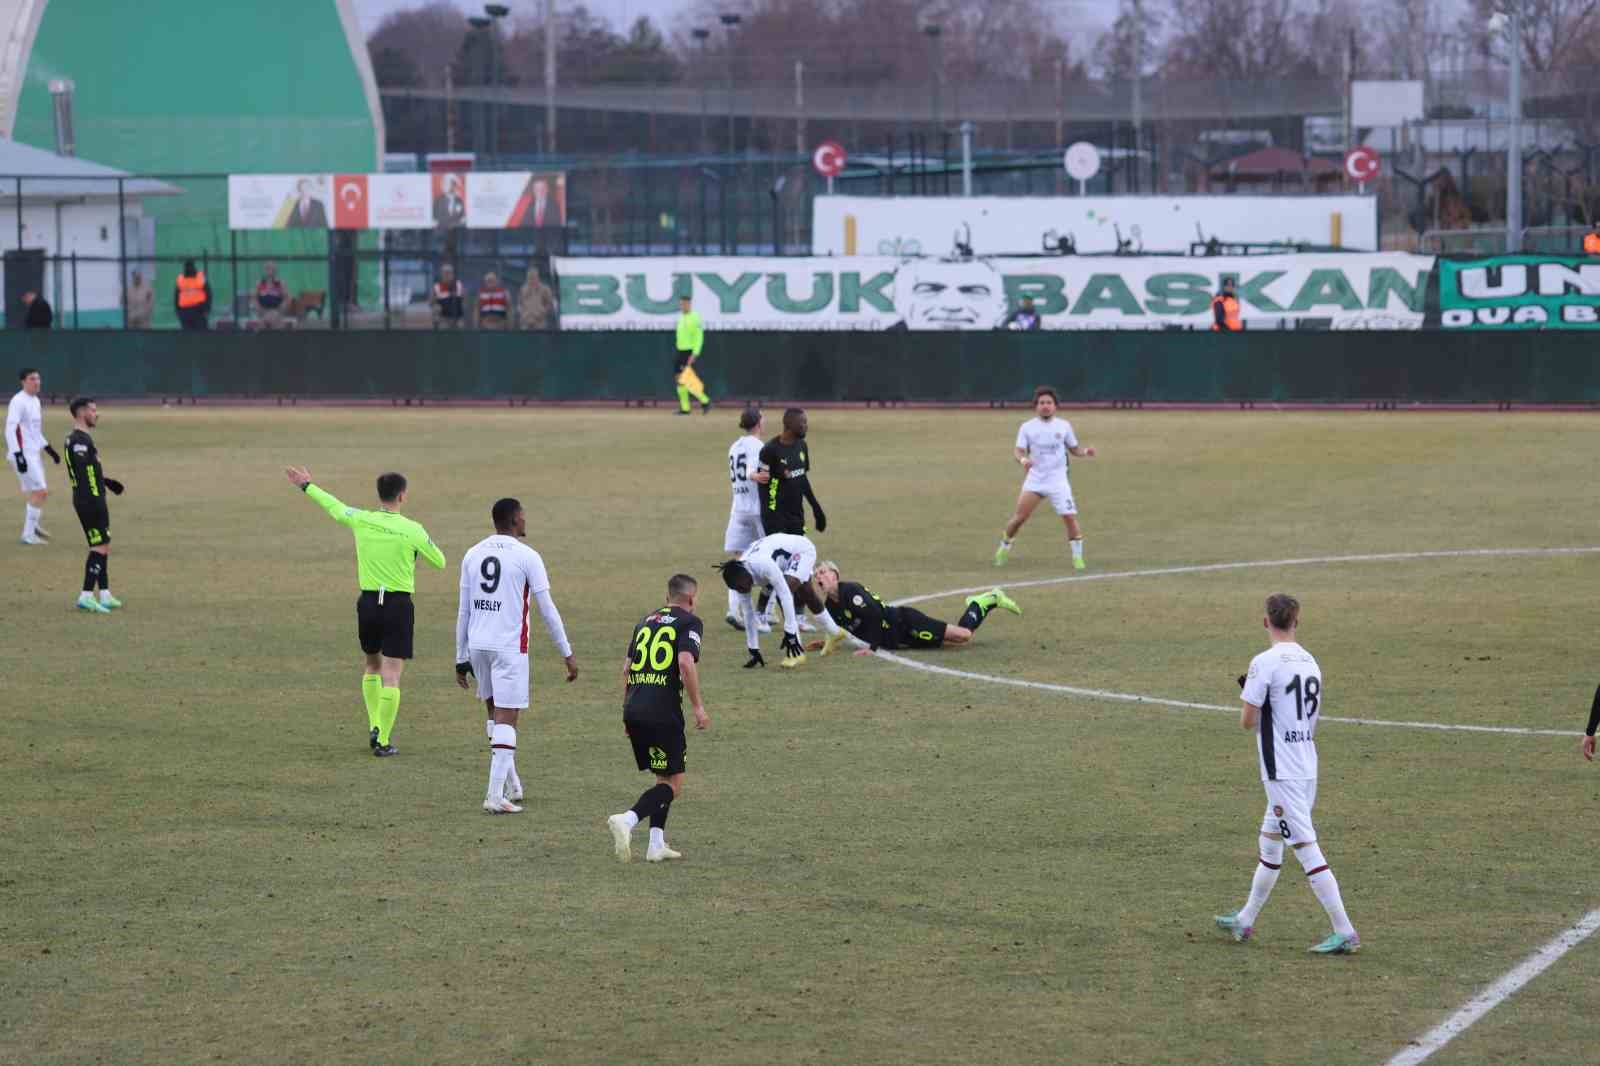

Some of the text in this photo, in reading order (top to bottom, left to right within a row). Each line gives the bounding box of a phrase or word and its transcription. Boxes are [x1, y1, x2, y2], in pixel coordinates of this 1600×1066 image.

[1441, 305, 1548, 328] OVA
[480, 556, 501, 594] 9
[473, 599, 502, 613] WESLEY
[630, 625, 677, 671] 36
[1284, 674, 1320, 720] 18
